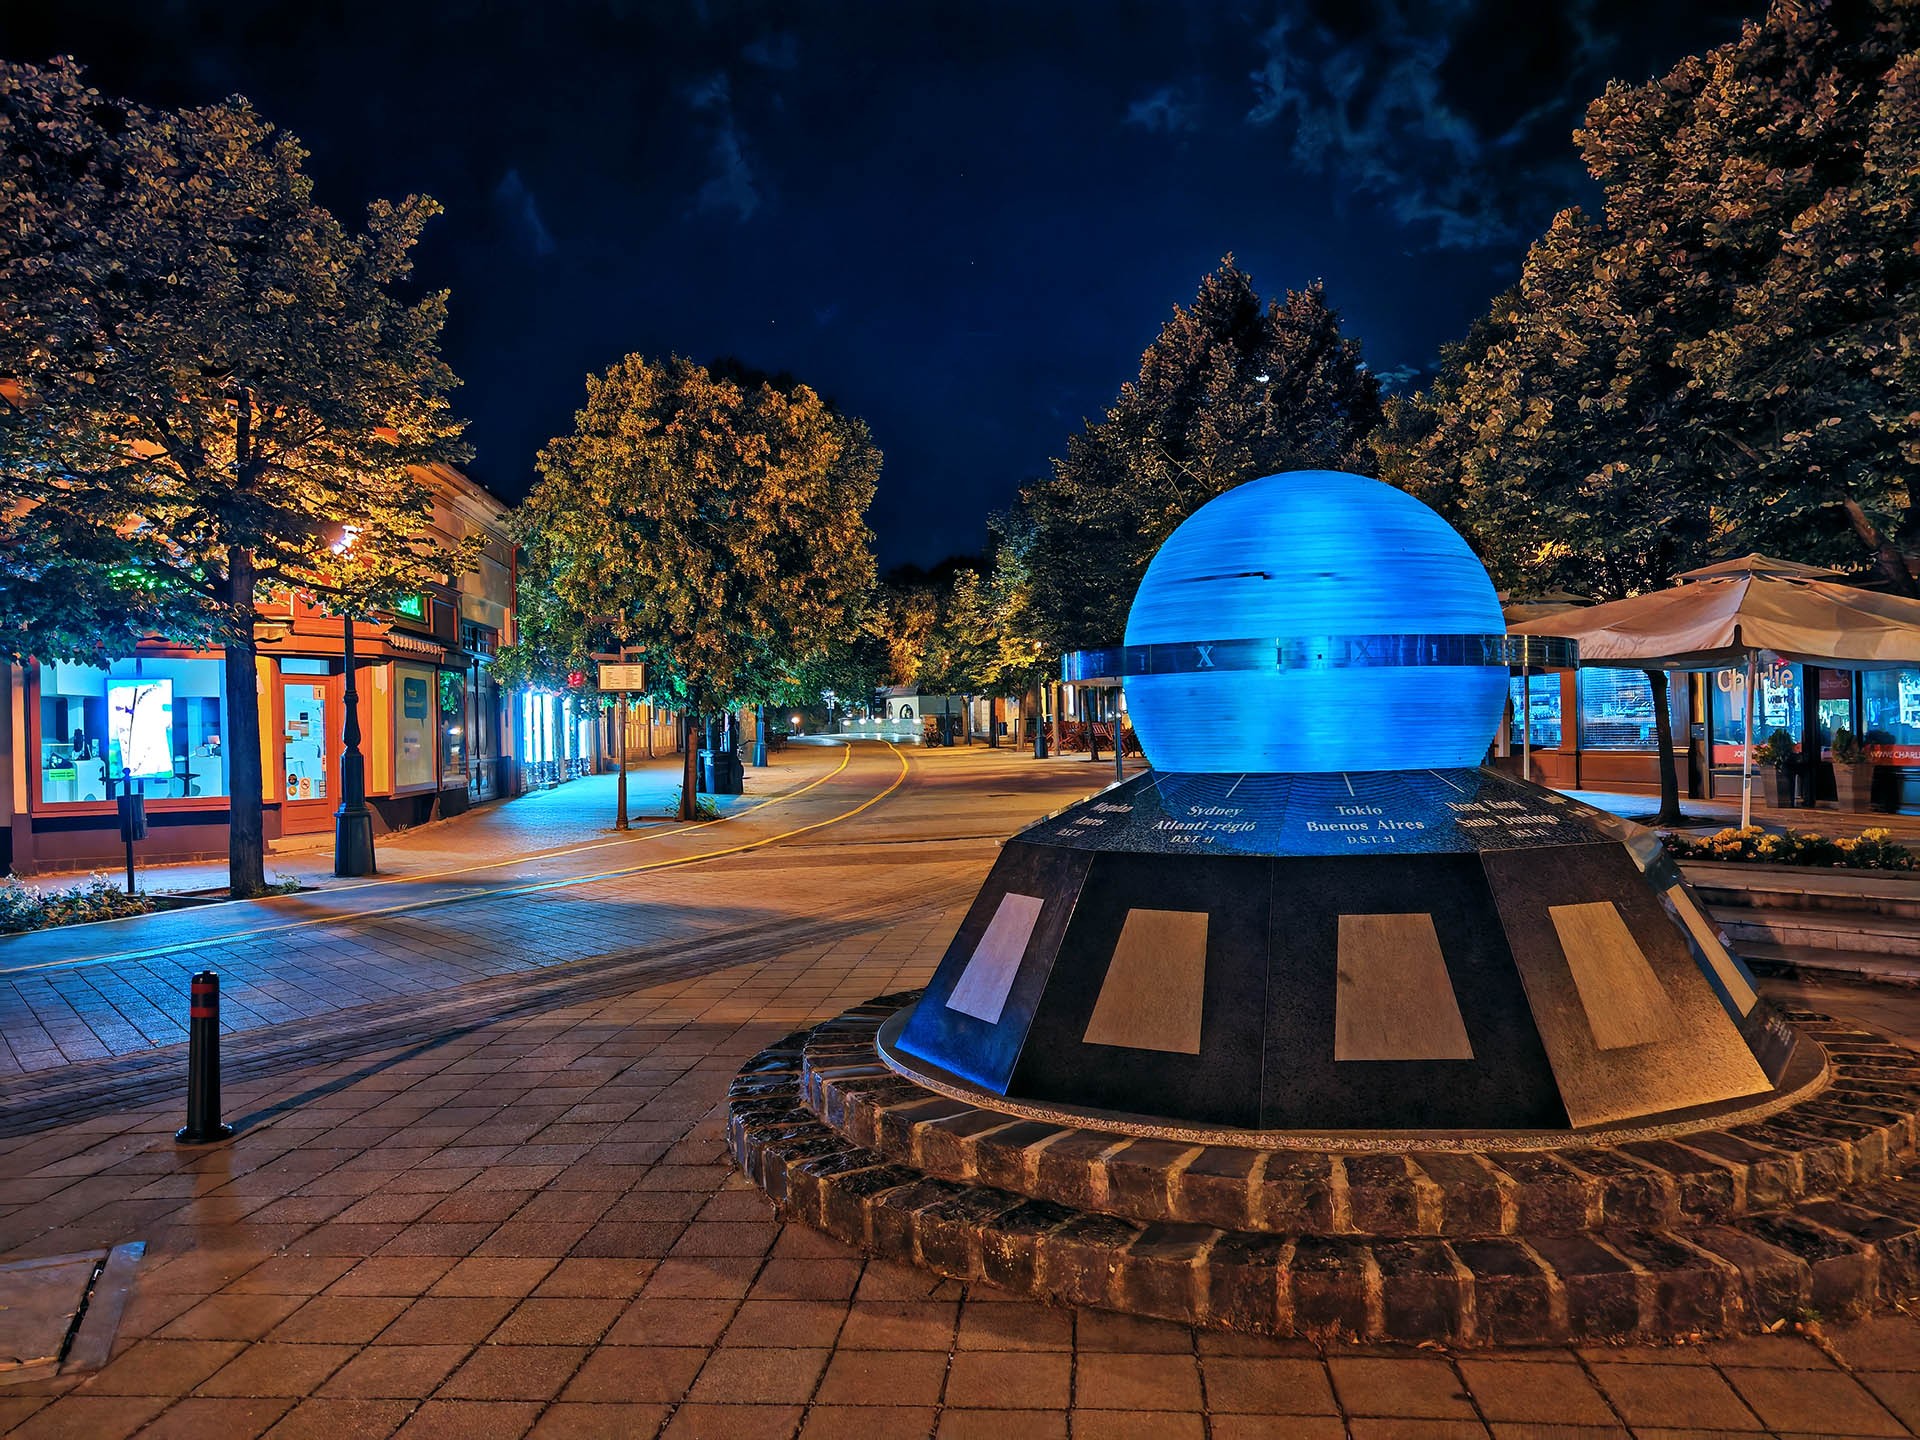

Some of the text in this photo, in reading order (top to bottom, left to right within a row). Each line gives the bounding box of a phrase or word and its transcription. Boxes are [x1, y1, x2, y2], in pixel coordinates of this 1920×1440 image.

[1196, 646, 1215, 667] X
[1187, 805, 1244, 817] Sydney
[1334, 805, 1383, 816] Tokio
[1444, 802, 1490, 813] Hong
[1484, 799, 1527, 811] Kong
[1306, 820, 1425, 832] Buenos Aires
[1454, 813, 1560, 827] Santo Domingo
[1346, 835, 1396, 844] D.S.T. ±1
